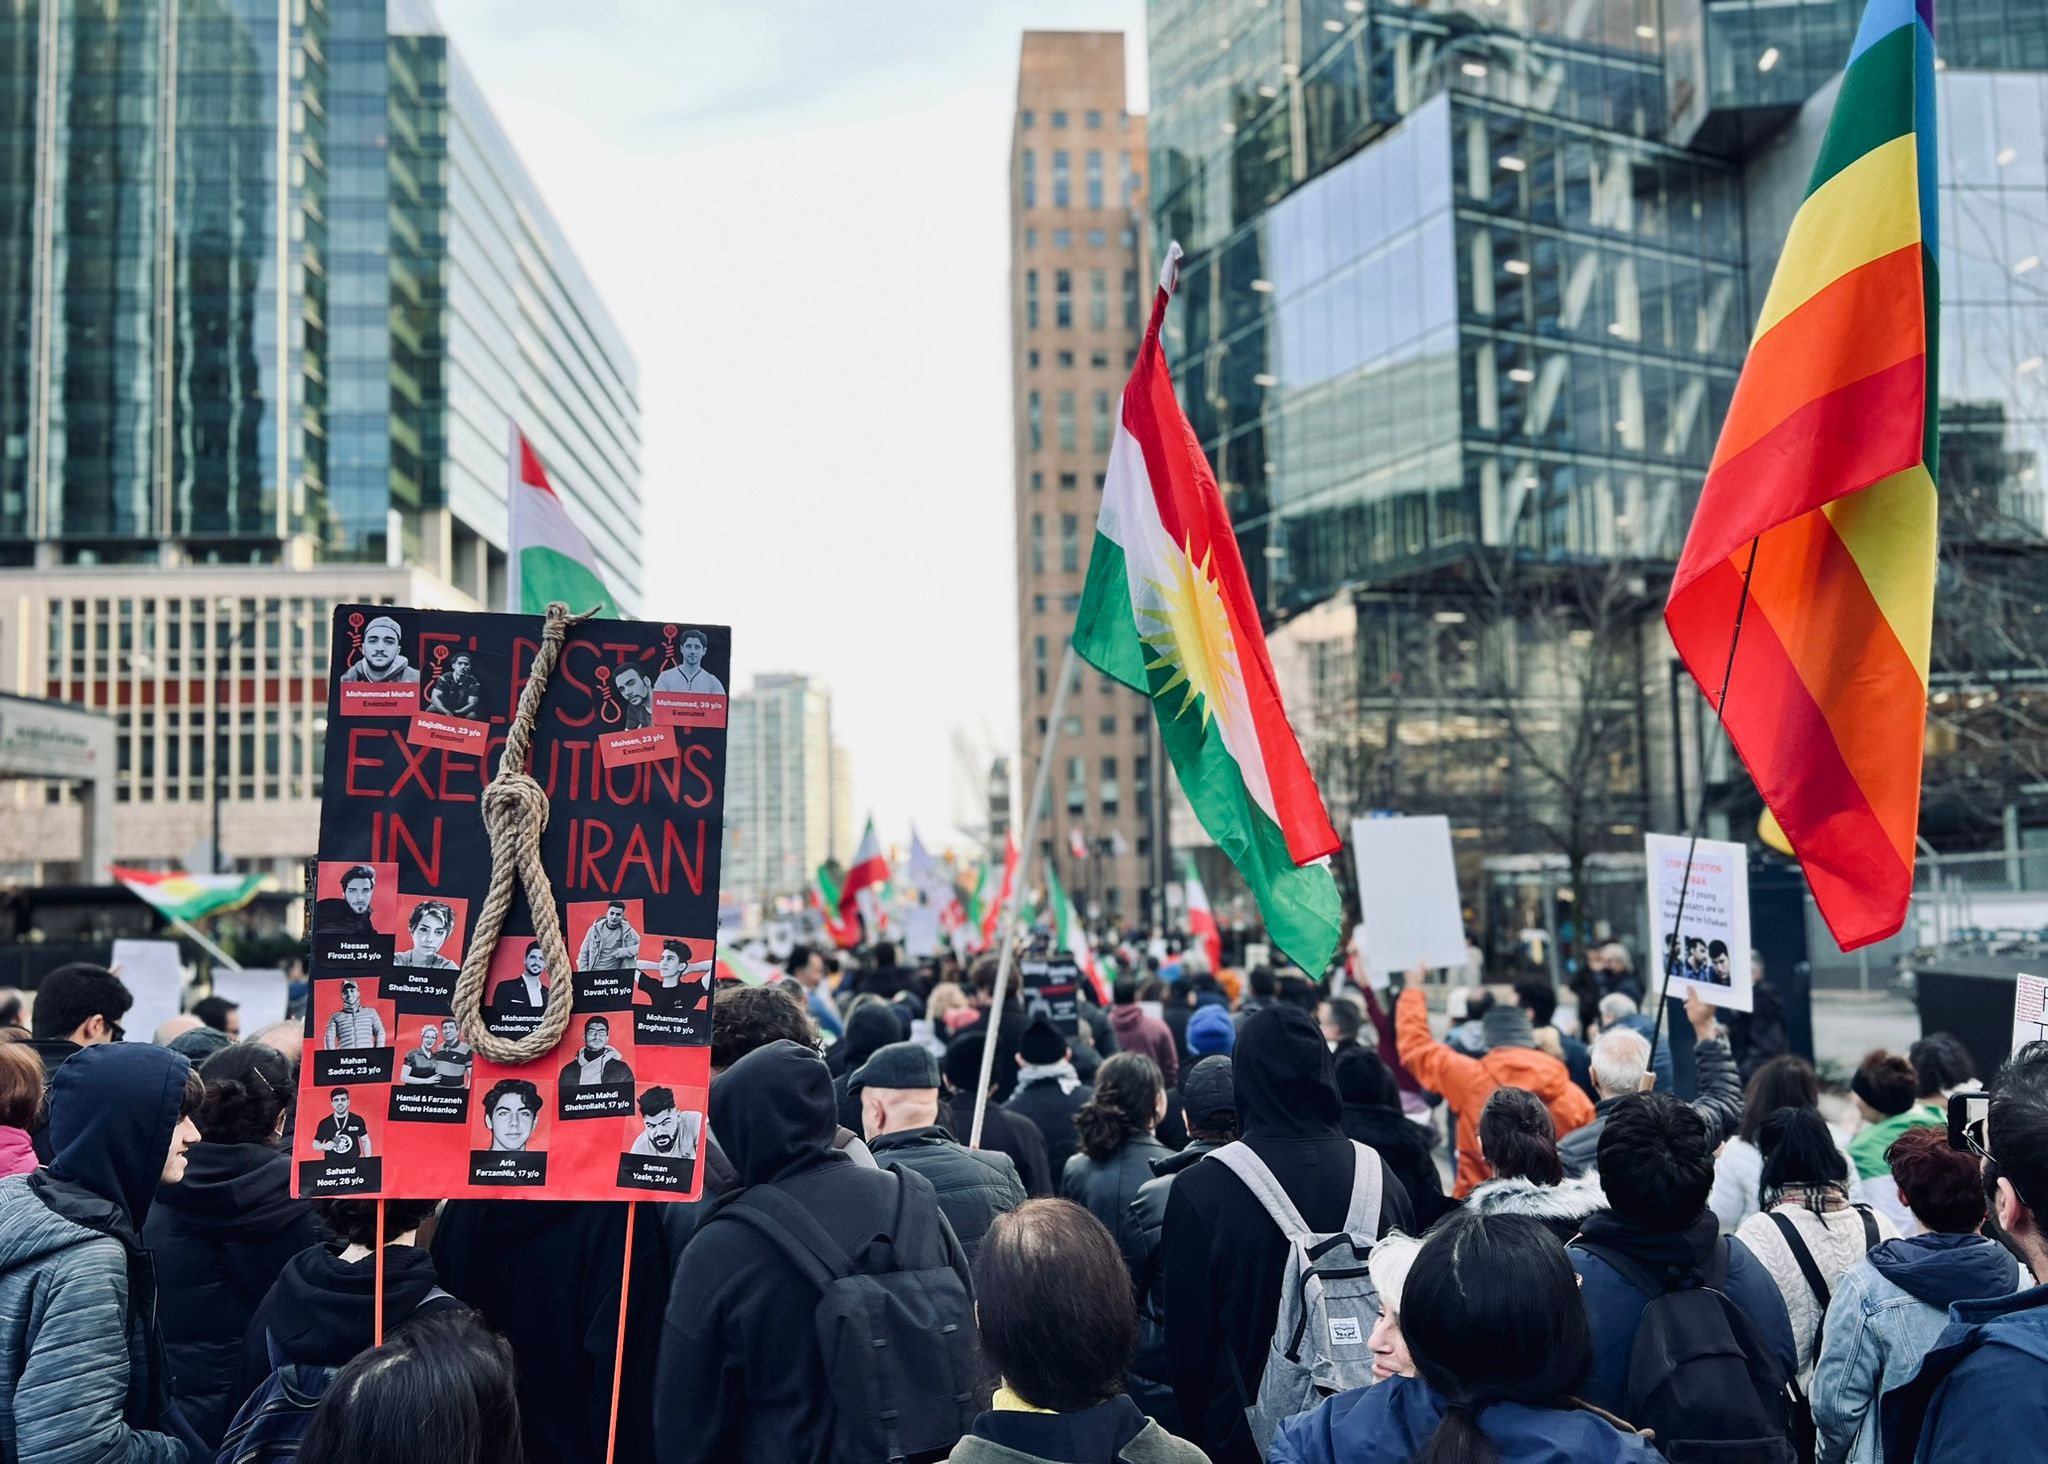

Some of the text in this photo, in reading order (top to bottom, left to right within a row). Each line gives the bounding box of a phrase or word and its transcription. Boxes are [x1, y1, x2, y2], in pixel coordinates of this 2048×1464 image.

[346, 690, 414, 698] Mohammad Mehdi
[656, 700, 698, 708] Mohammad,
[710, 702, 722, 710] y/o
[611, 739, 642, 748] Mohsen,
[653, 734, 664, 742] y/o
[623, 745, 656, 755] Executed
[371, 811, 705, 895] IN IRAN
[328, 952, 356, 960] Firouzi,
[369, 952, 382, 961] y/o
[408, 975, 428, 983] Dena
[388, 984, 422, 994] Sheibani,
[435, 987, 448, 995] y/o
[584, 988, 609, 996] Davari,
[620, 987, 631, 995] y/o
[646, 1014, 688, 1023] Mohammad
[638, 1023, 671, 1033] Broghani,
[328, 1067, 356, 1076] Sadrat,
[368, 1067, 381, 1075] y/o
[396, 1094, 420, 1102] Hamid
[428, 1096, 462, 1104] Farzaneh
[596, 1091, 618, 1099] Mahdi
[423, 1106, 457, 1114] Hasanloo
[565, 1102, 607, 1112] Shokrollahi,
[617, 1100, 629, 1109] y/o
[326, 1167, 356, 1175] Sahand
[643, 1164, 668, 1172] Saman
[527, 1170, 539, 1178] y/o
[633, 1173, 654, 1182] Yasin,
[665, 1176, 678, 1184] y/o
[351, 1177, 364, 1186] y/o
